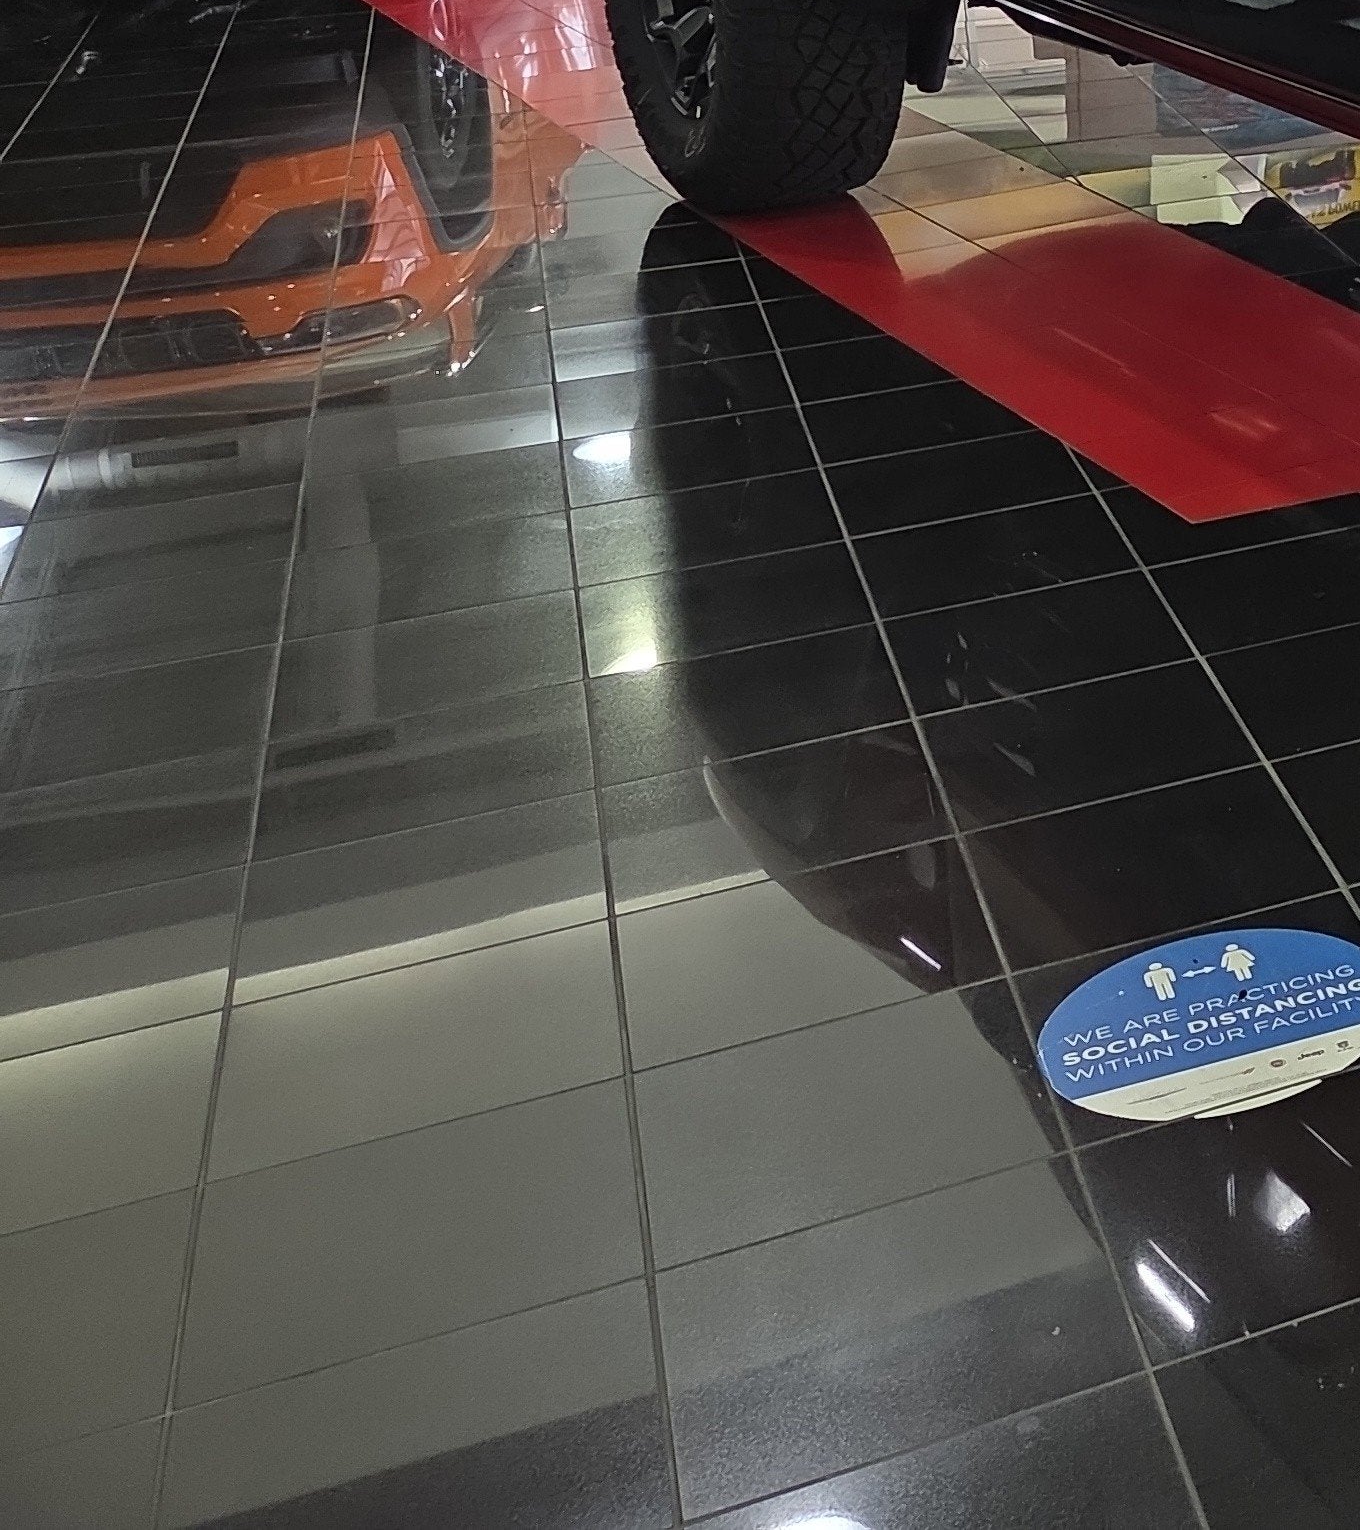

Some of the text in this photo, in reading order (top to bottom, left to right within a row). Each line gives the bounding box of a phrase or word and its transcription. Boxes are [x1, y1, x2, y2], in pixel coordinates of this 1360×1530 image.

[1063, 964, 1356, 1048] WE ARE PRACTICING
[1062, 1027, 1181, 1067] SOCIAL
[1064, 1046, 1174, 1083] WITHIN
[1184, 1027, 1246, 1053] OUR
